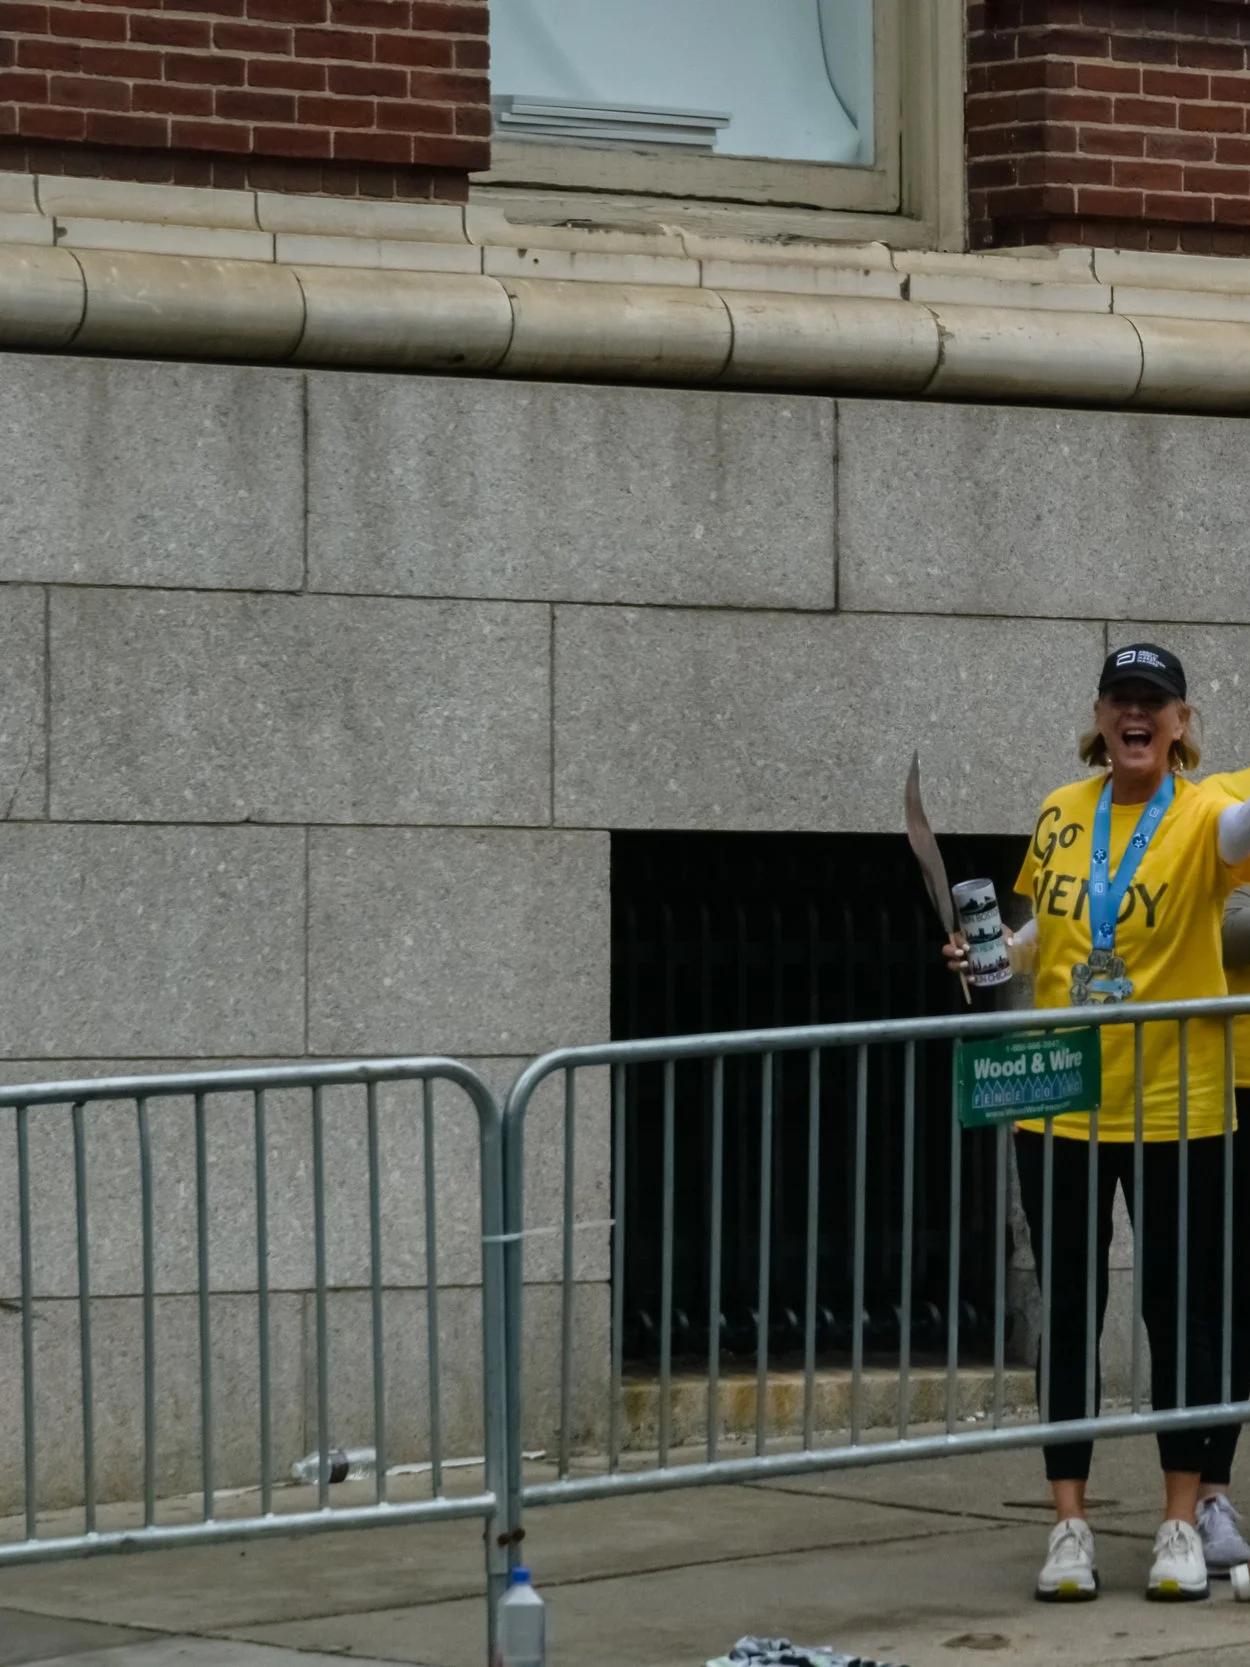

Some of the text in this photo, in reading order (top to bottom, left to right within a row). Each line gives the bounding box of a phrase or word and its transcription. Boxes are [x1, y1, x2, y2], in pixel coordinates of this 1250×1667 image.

[1033, 806, 1085, 868] Go
[974, 1047, 1082, 1079] Wood & Wire
[974, 1090, 1021, 1105] FENCE
[1034, 1087, 1050, 1098] CO
